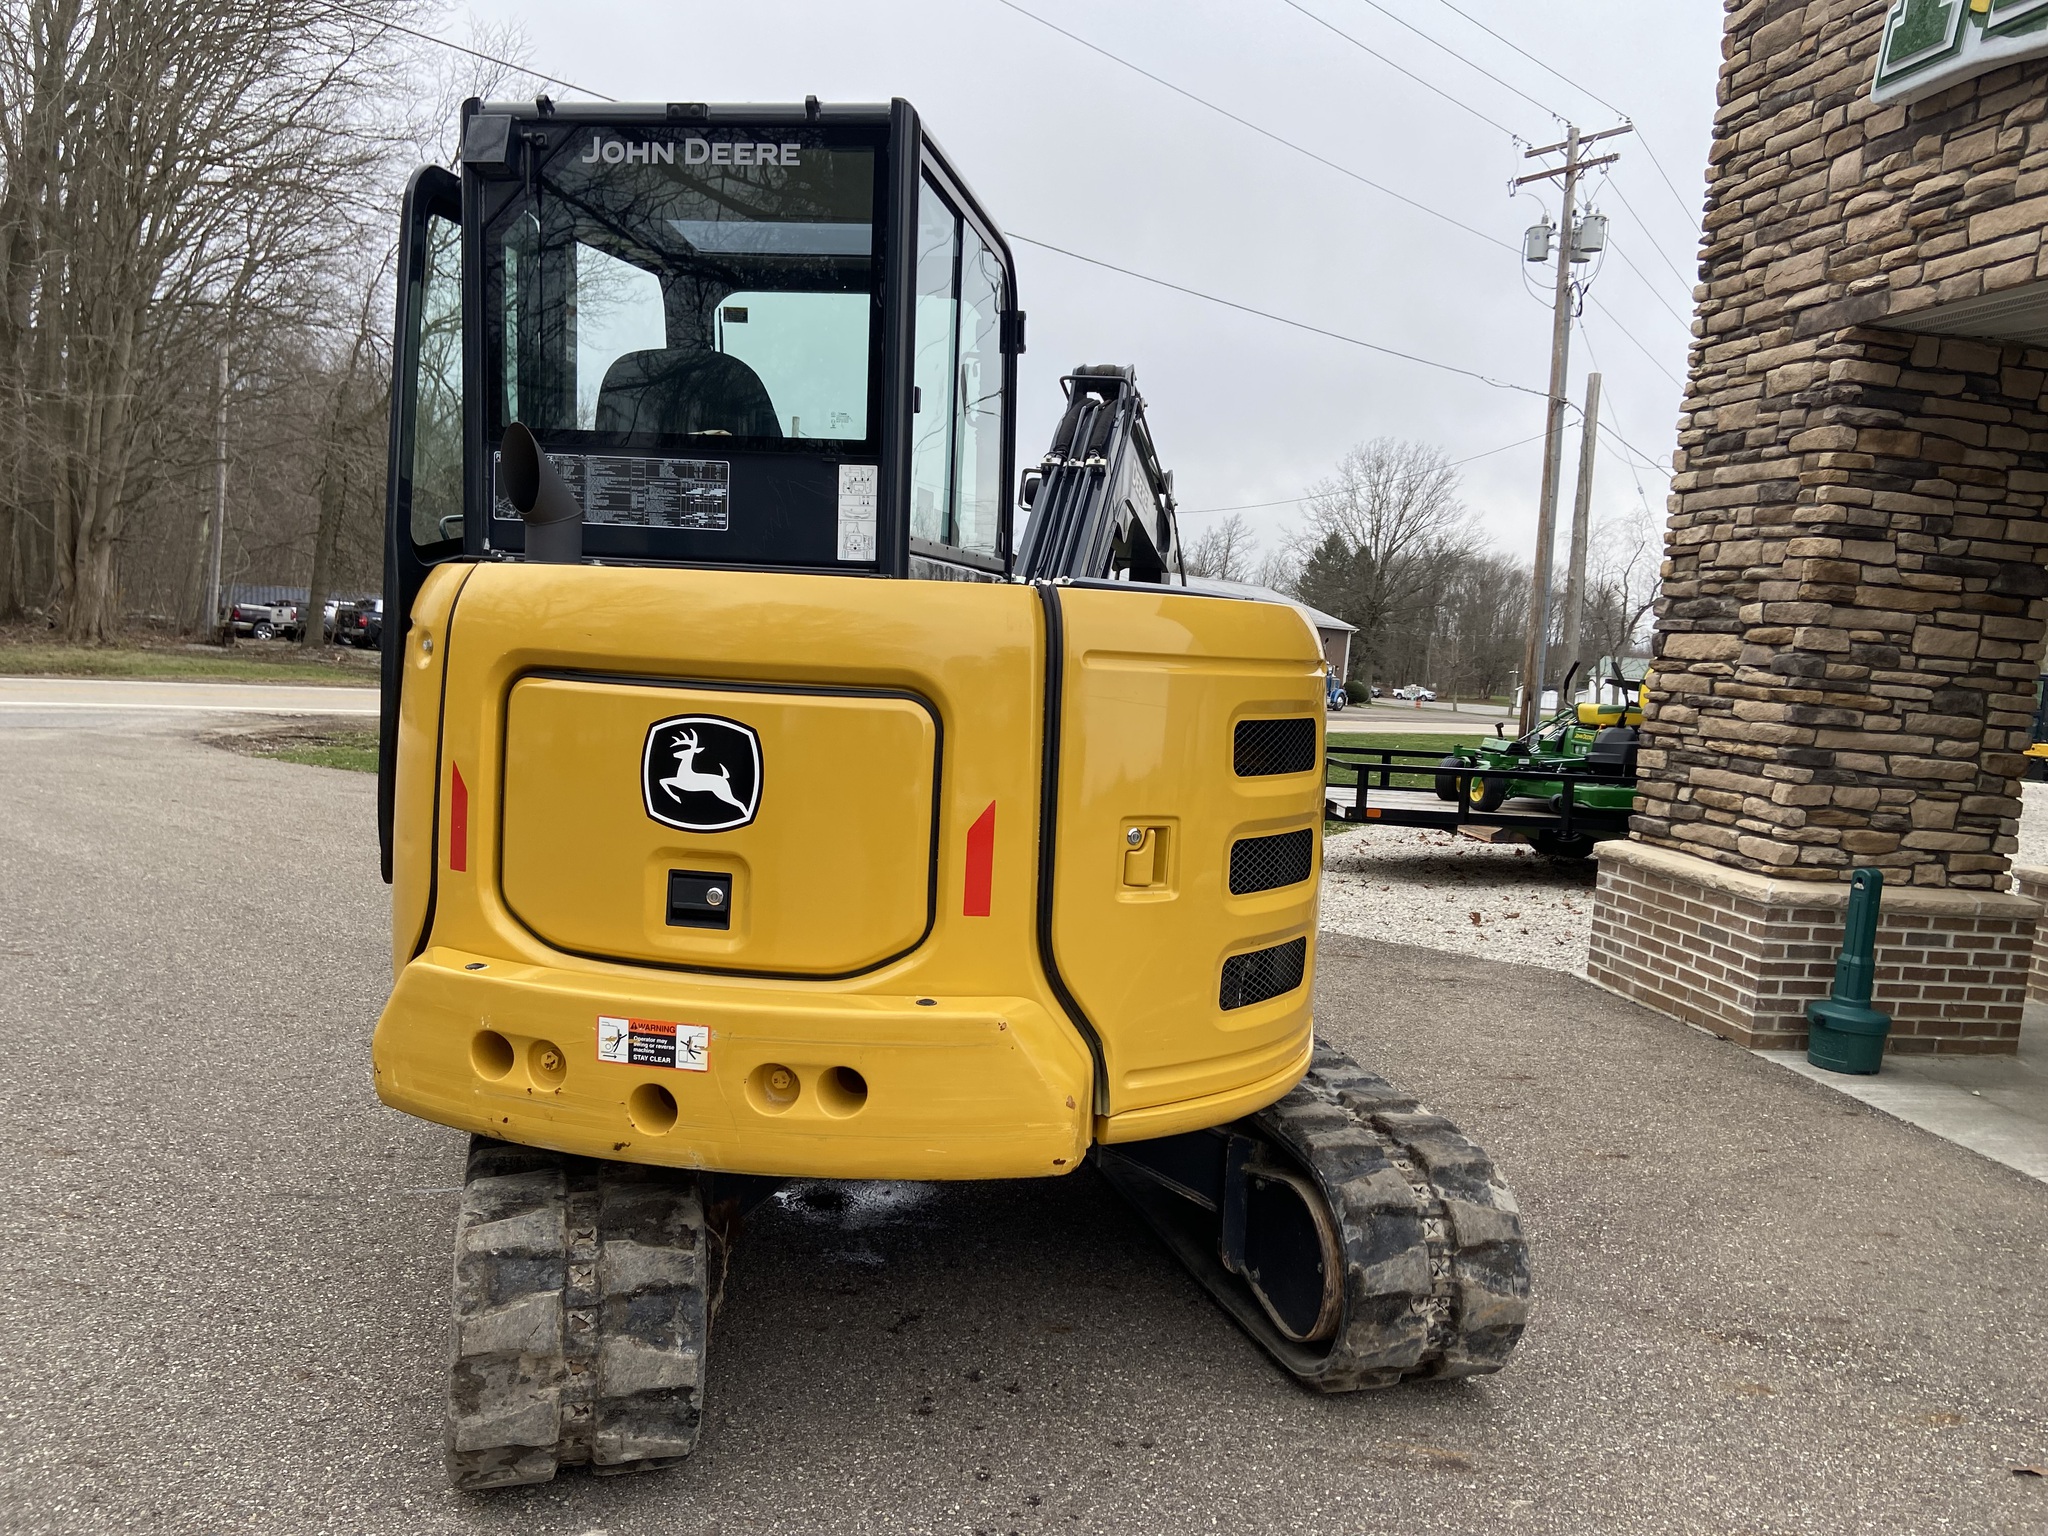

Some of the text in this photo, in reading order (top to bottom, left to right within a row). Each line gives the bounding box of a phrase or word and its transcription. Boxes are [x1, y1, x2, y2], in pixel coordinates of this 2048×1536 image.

[581, 136, 801, 166] JOHN DEERE
[638, 1022, 676, 1033] WARNING
[633, 1035, 656, 1043] Operator
